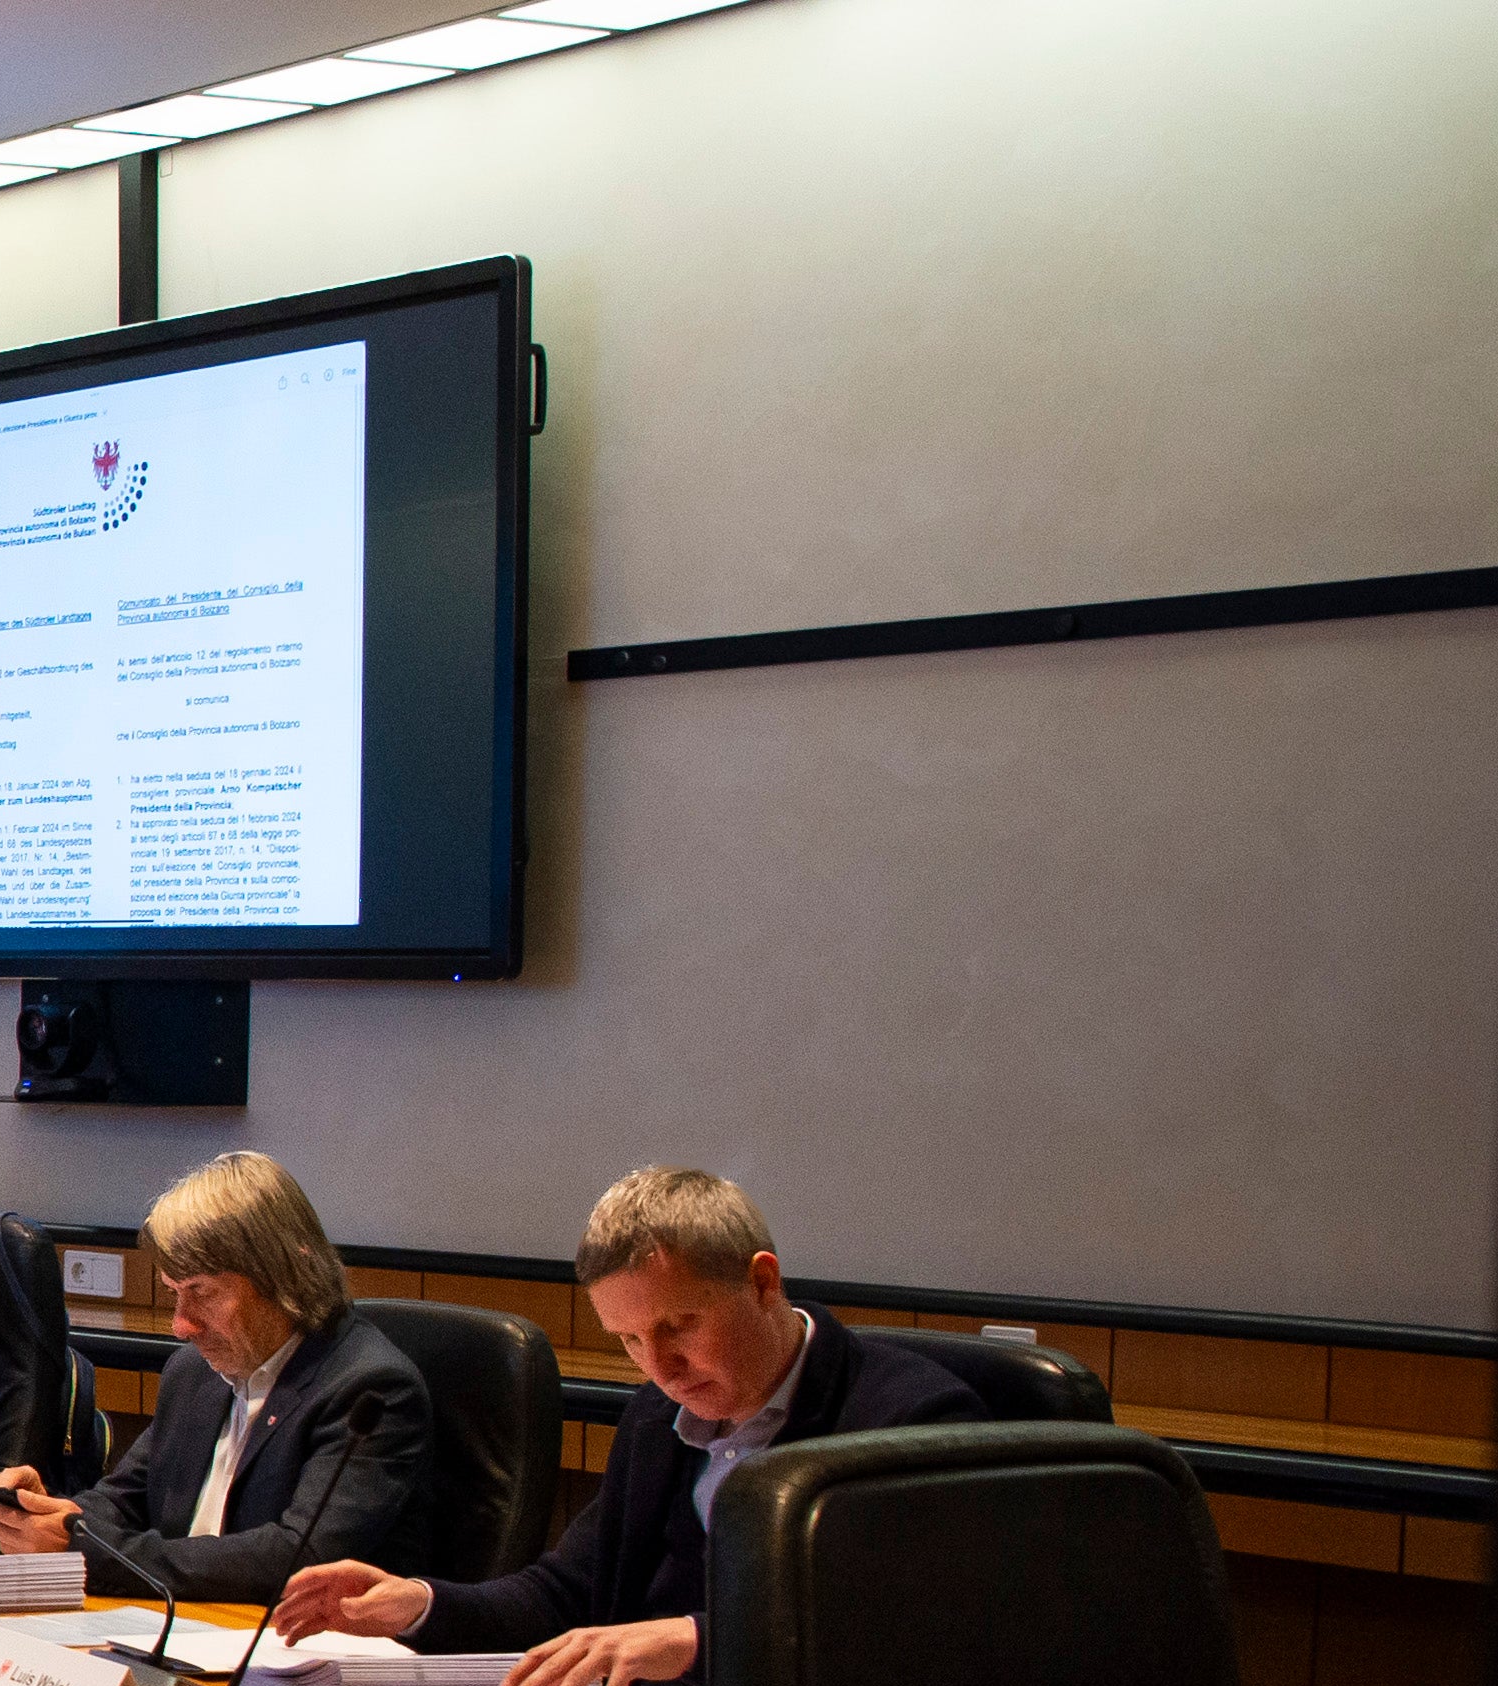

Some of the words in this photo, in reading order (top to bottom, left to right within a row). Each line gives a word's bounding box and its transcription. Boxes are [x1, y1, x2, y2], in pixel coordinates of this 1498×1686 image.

[25, 521, 59, 531] autonoma
[60, 518, 67, 527] di
[68, 516, 96, 525] Bolzano
[117, 597, 160, 611] Comunicato
[165, 594, 177, 606] del
[182, 590, 221, 604] Presidente
[226, 588, 239, 600] del
[243, 584, 278, 598] Consiglio
[284, 580, 303, 593] della
[117, 613, 150, 626] Provincia
[153, 609, 189, 622] autonoma
[191, 606, 197, 618] di
[200, 605, 230, 617] Bolzano
[117, 658, 124, 667] Ai
[129, 658, 148, 666] sensi
[197, 650, 205, 660] 12
[209, 649, 221, 659] del
[224, 646, 271, 659] regolamento
[276, 642, 303, 652] interno
[117, 673, 127, 682] del
[130, 670, 163, 681] Consiglio
[165, 668, 182, 678] della
[185, 665, 219, 675] Provincia
[221, 662, 258, 673] autonoma
[260, 659, 267, 669] di
[269, 658, 300, 668] Bolzano
[194, 695, 229, 705] comunica
[116, 733, 129, 741] che
[137, 729, 168, 740] Consiglio
[170, 728, 186, 737] della
[188, 726, 221, 735] Provincia
[223, 723, 258, 733] autonoma
[260, 721, 267, 731] di
[269, 720, 300, 730] Bolzano
[130, 789, 169, 800] consigliere
[175, 785, 215, 797] provinciale
[221, 785, 240, 794] Arno
[246, 781, 302, 793] Kompatscher
[130, 804, 171, 813] Presidente
[174, 803, 192, 811] della
[9, 1665, 35, 1686] Luis
